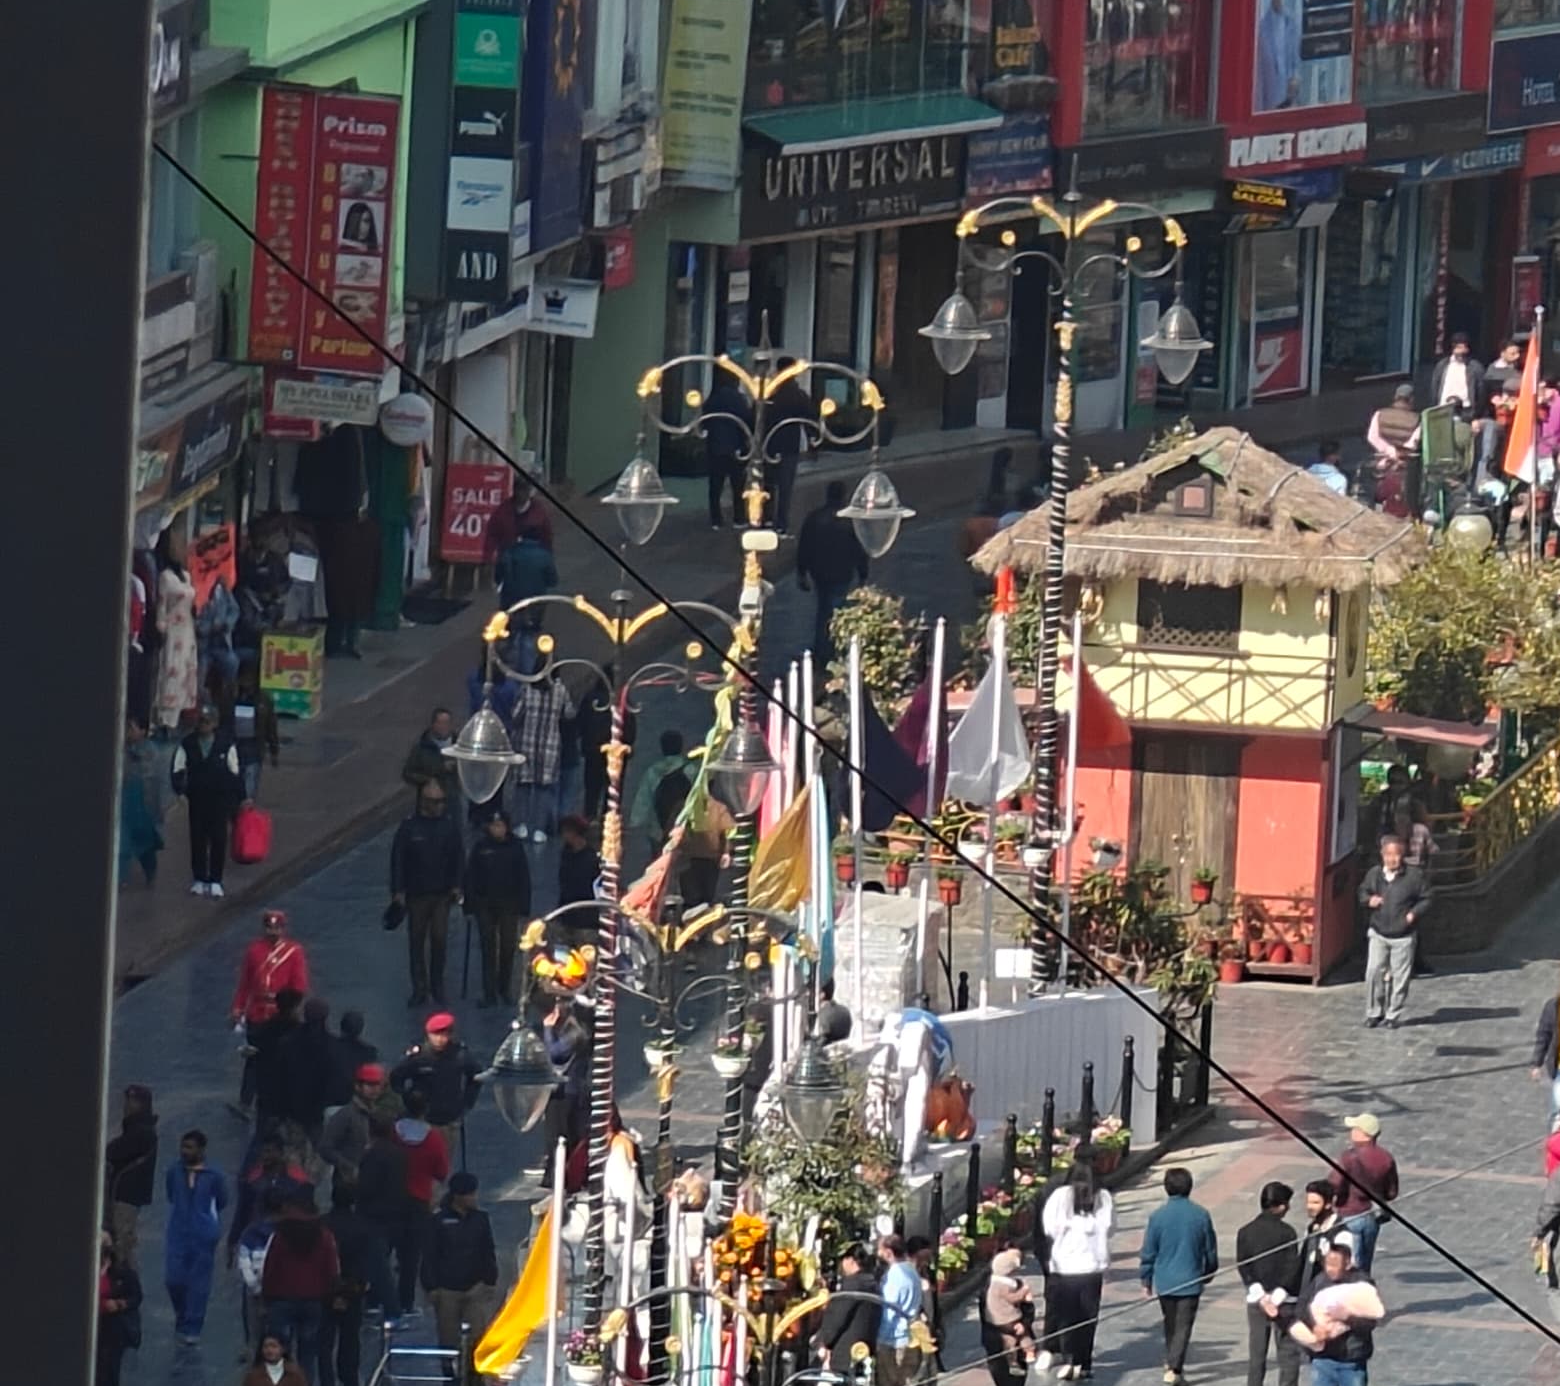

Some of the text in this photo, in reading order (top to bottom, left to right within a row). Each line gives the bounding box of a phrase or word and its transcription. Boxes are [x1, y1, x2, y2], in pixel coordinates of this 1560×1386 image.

[322, 115, 387, 137] Prism
[1462, 141, 1522, 170] CONVERSE
[765, 140, 955, 202] UNIVERSAL
[457, 250, 498, 281] AND
[452, 487, 501, 505] SALE
